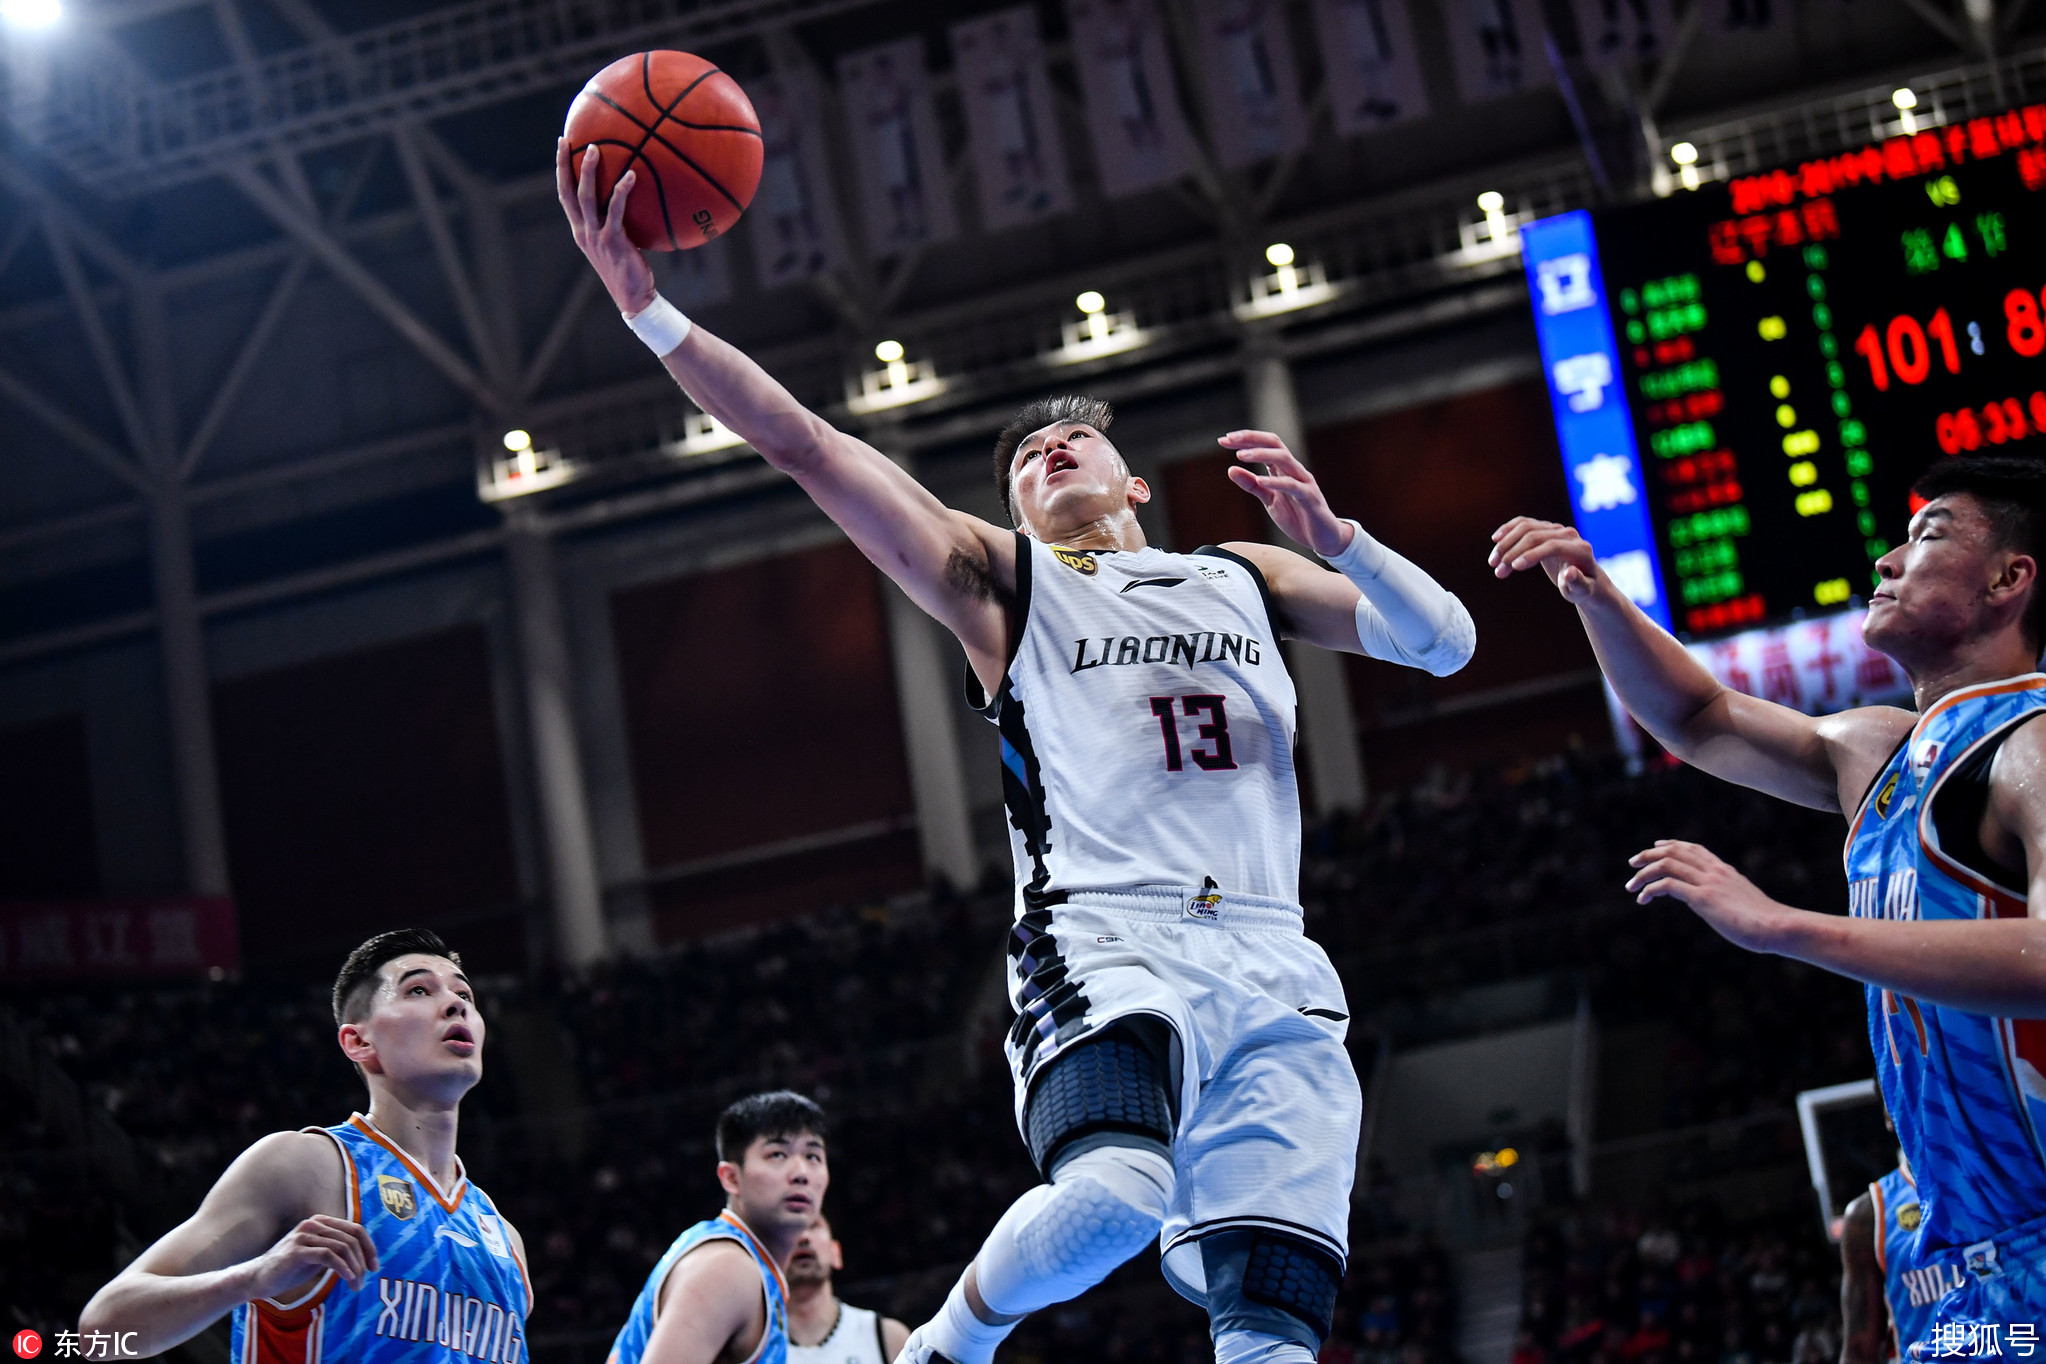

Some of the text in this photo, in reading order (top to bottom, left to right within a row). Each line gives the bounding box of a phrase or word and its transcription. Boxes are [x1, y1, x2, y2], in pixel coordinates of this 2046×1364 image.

[1855, 306, 1962, 392] 101
[1070, 631, 1261, 675] LIAONING
[1149, 694, 1239, 772] 13
[376, 1277, 522, 1364] XINJIANG
